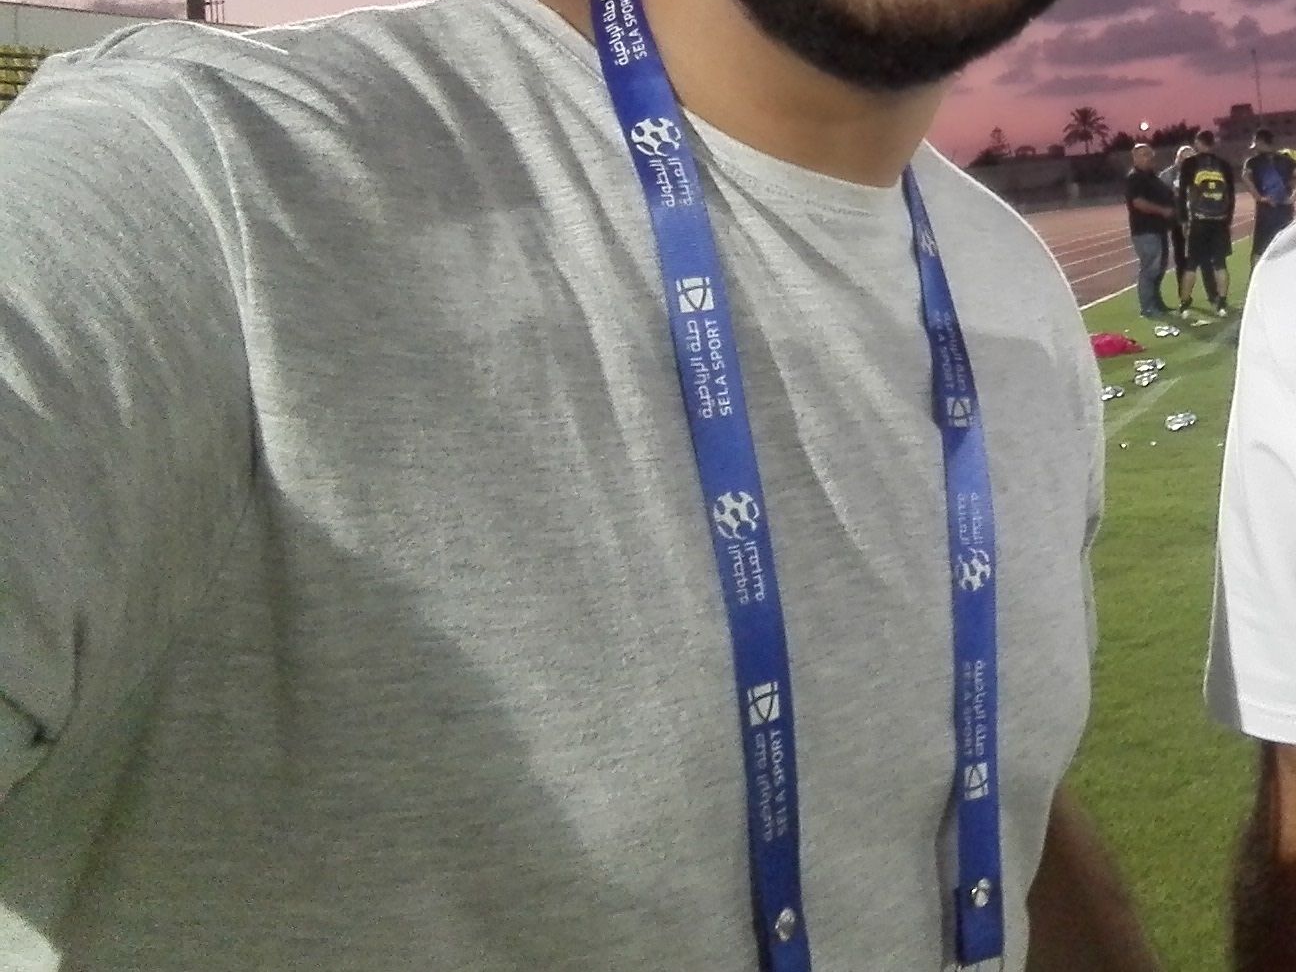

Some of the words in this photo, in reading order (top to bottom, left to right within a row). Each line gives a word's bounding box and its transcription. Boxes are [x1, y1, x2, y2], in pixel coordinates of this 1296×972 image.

[629, 28, 647, 60] SELA
[705, 318, 724, 370] SPORT
[715, 374, 733, 416] SELA
